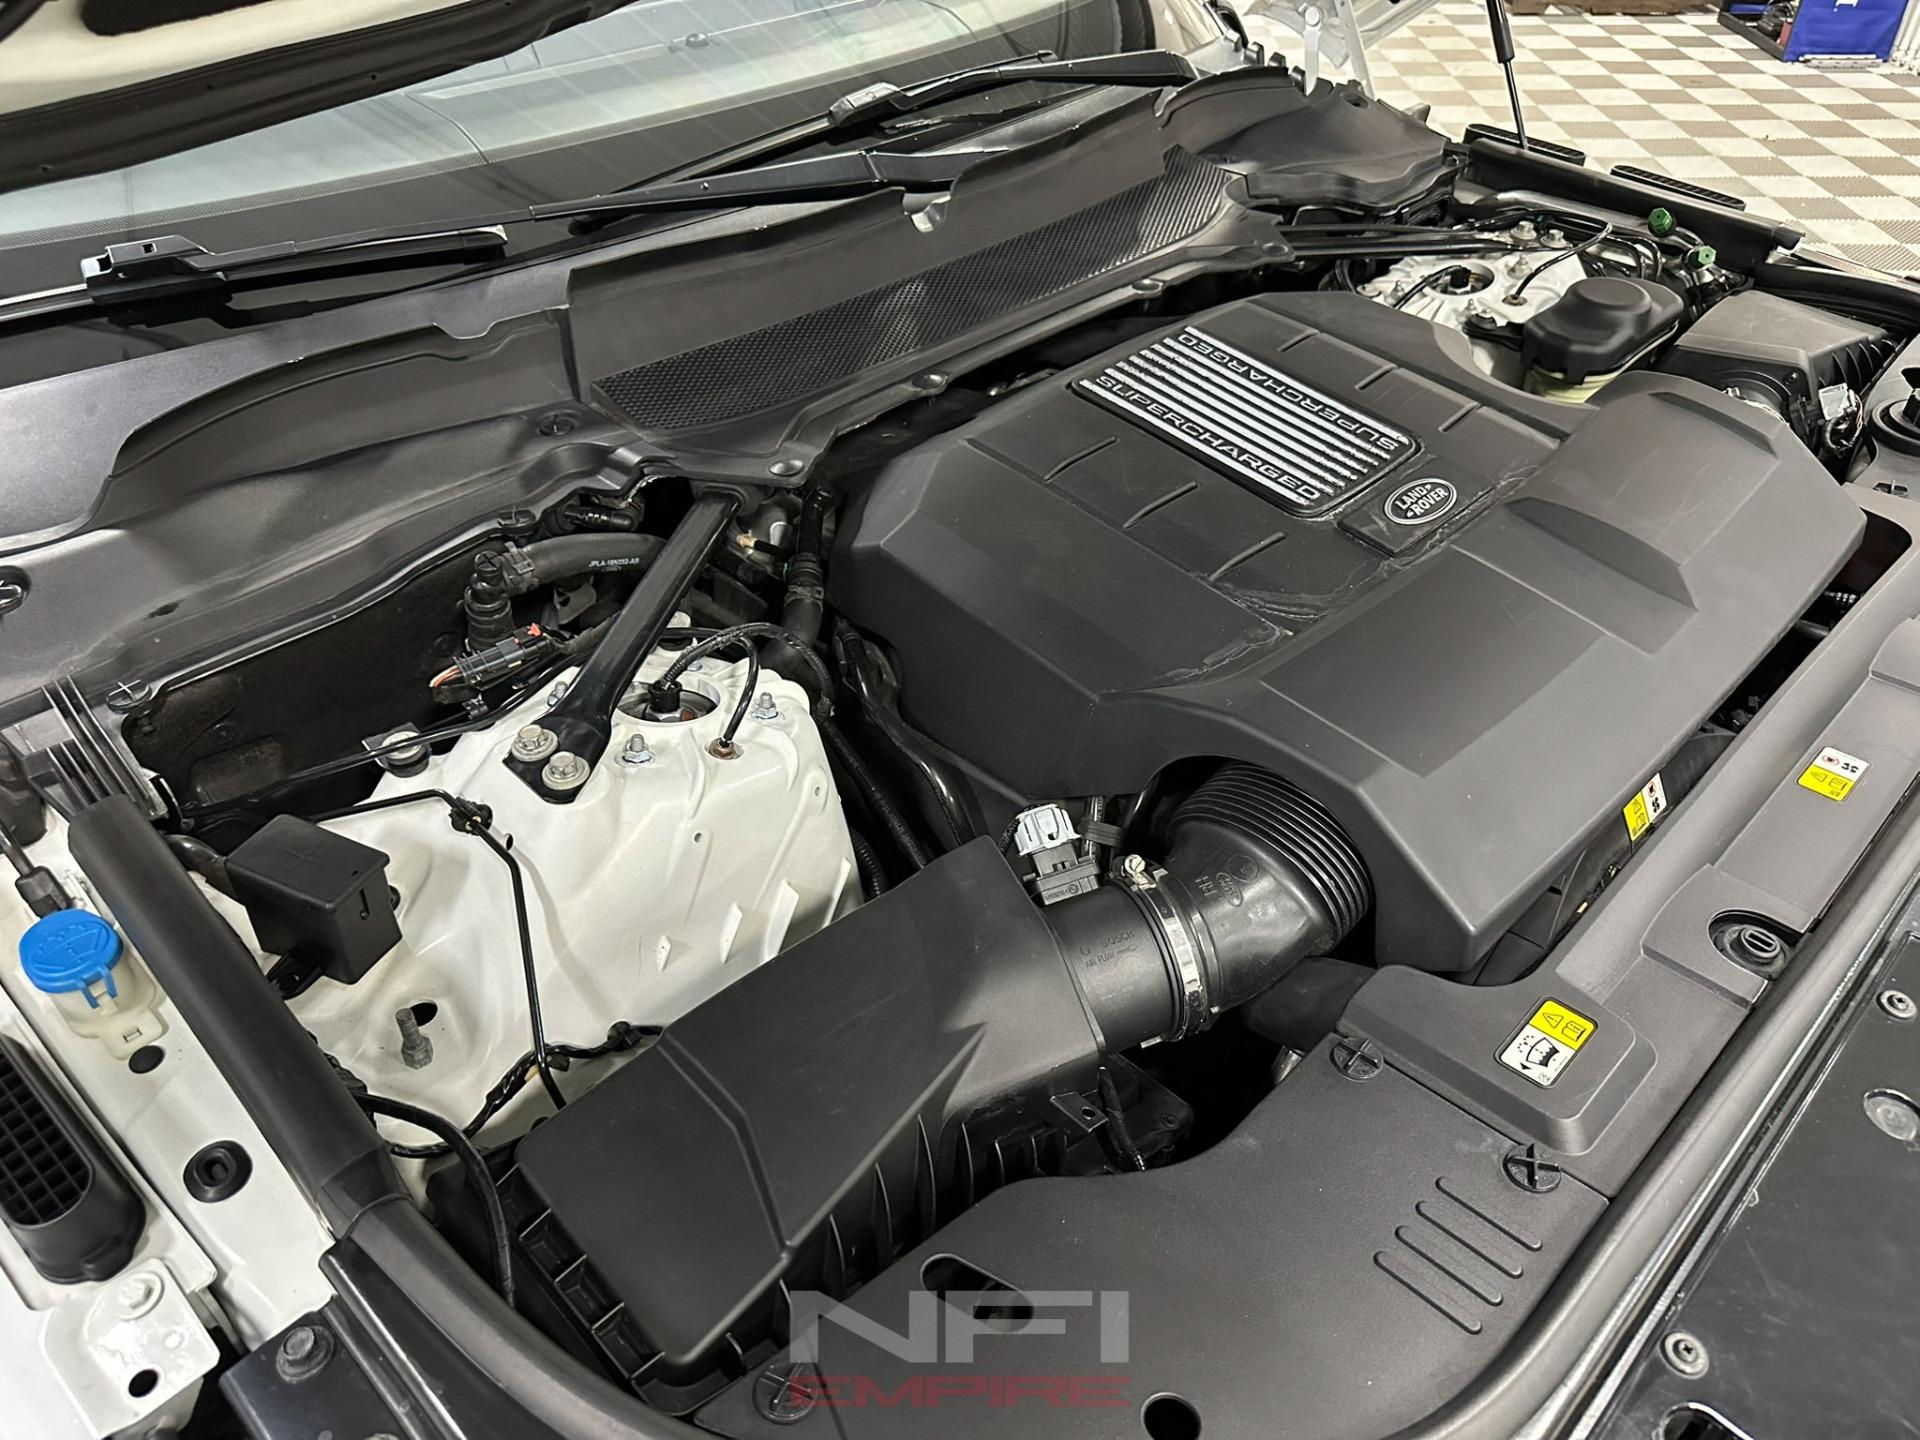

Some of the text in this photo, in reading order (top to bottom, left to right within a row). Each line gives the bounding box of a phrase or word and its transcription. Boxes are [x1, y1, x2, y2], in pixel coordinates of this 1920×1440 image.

[1178, 333, 1398, 451] SUPERCHARGED
[1095, 375, 1321, 501] SUPERCHARGED
[1395, 486, 1427, 510] LAND
[1409, 487, 1449, 516] ROVER
